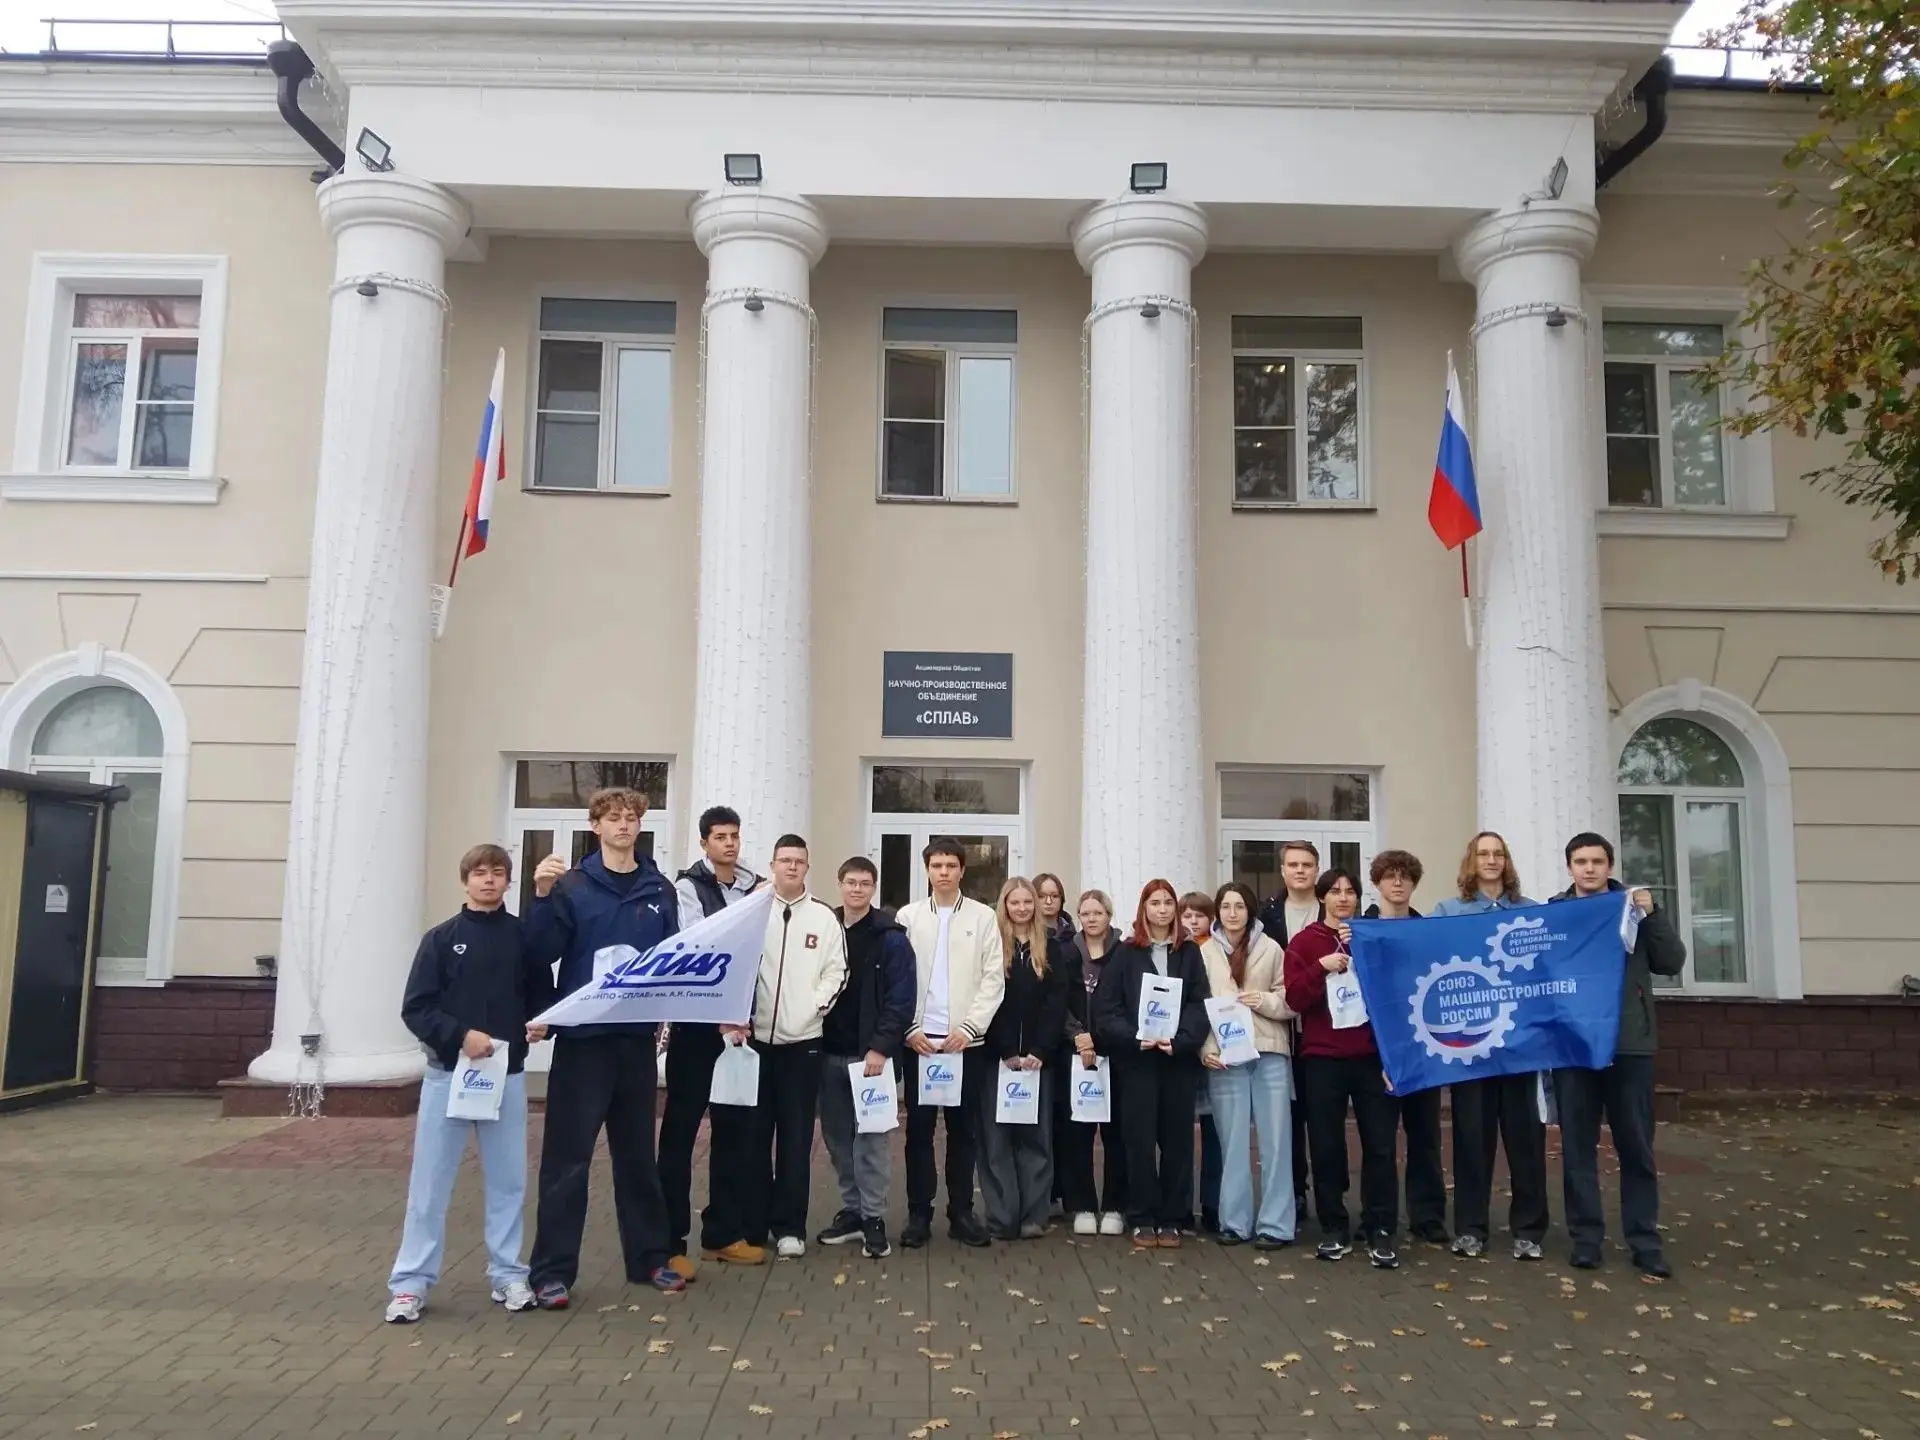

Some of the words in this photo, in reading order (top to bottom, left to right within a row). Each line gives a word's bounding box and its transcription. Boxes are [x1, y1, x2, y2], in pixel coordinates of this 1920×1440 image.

[888, 680, 1007, 690] НАУЧНО-ПРОИЗВОДСТВЕННОЕ
[918, 692, 978, 702] ОБЪЕДИНЕНИЕ
[916, 710, 979, 724] «СПЛАВ»
[1509, 933, 1568, 946] РЕГИОНАЛЬНОЕ
[1510, 927, 1548, 939] ТУЛЬСКОЕ
[1510, 942, 1552, 955] ОТДЕЛЕНИЕ
[1438, 975, 1475, 992] СОЮЗ
[1439, 979, 1577, 1008] МАШИНОСТРОИТЕЛЕЙ
[1441, 1007, 1492, 1024] РОССИИ
